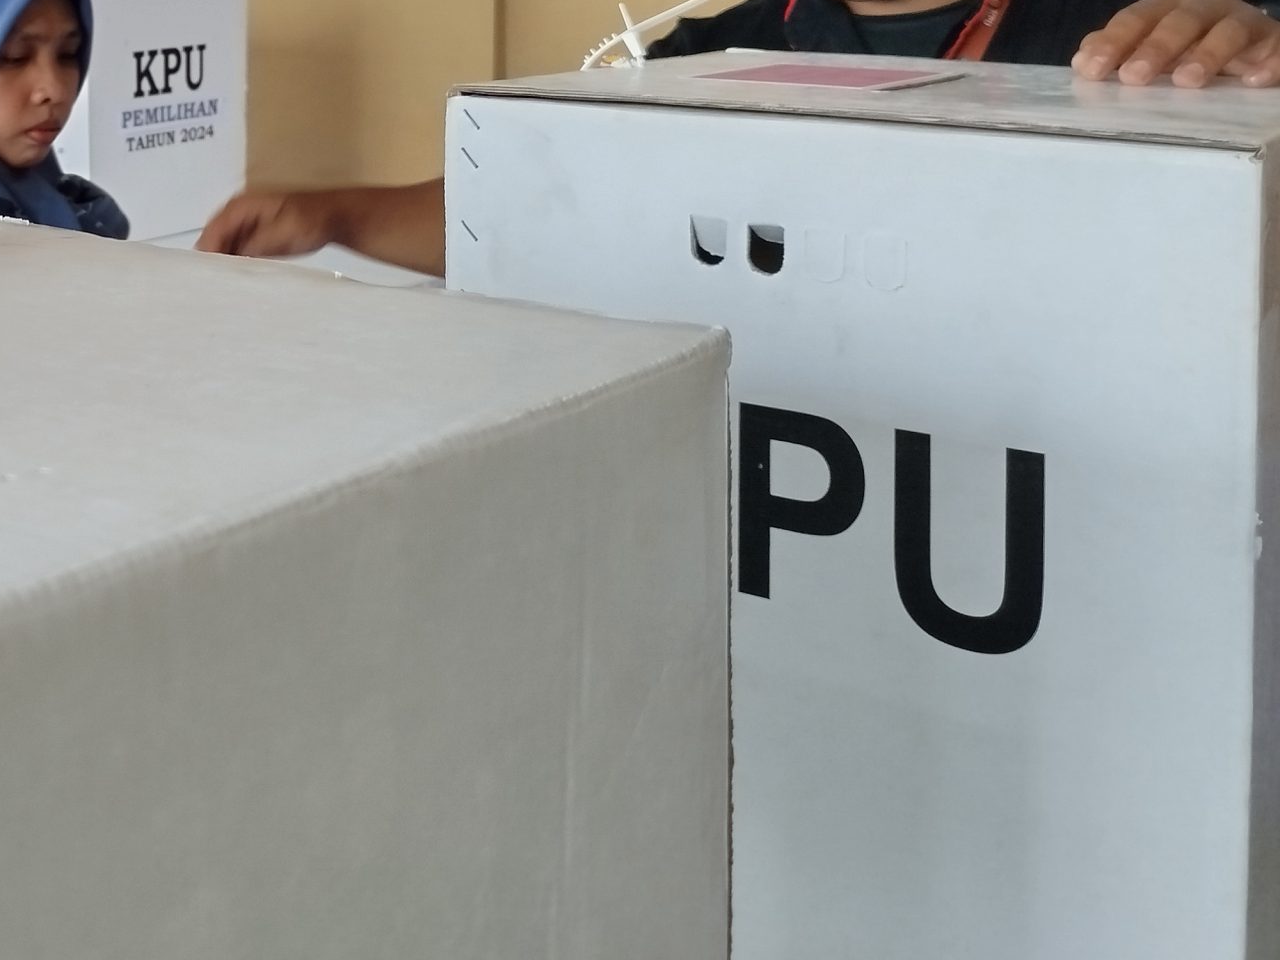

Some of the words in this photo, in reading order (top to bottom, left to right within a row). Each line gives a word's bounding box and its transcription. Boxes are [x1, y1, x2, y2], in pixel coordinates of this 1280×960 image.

[133, 43, 206, 98] KPU
[122, 98, 219, 129] PEMILIHAN
[126, 130, 176, 152] TAHUN
[180, 124, 214, 142] 2024
[738, 402, 1046, 654] PU
